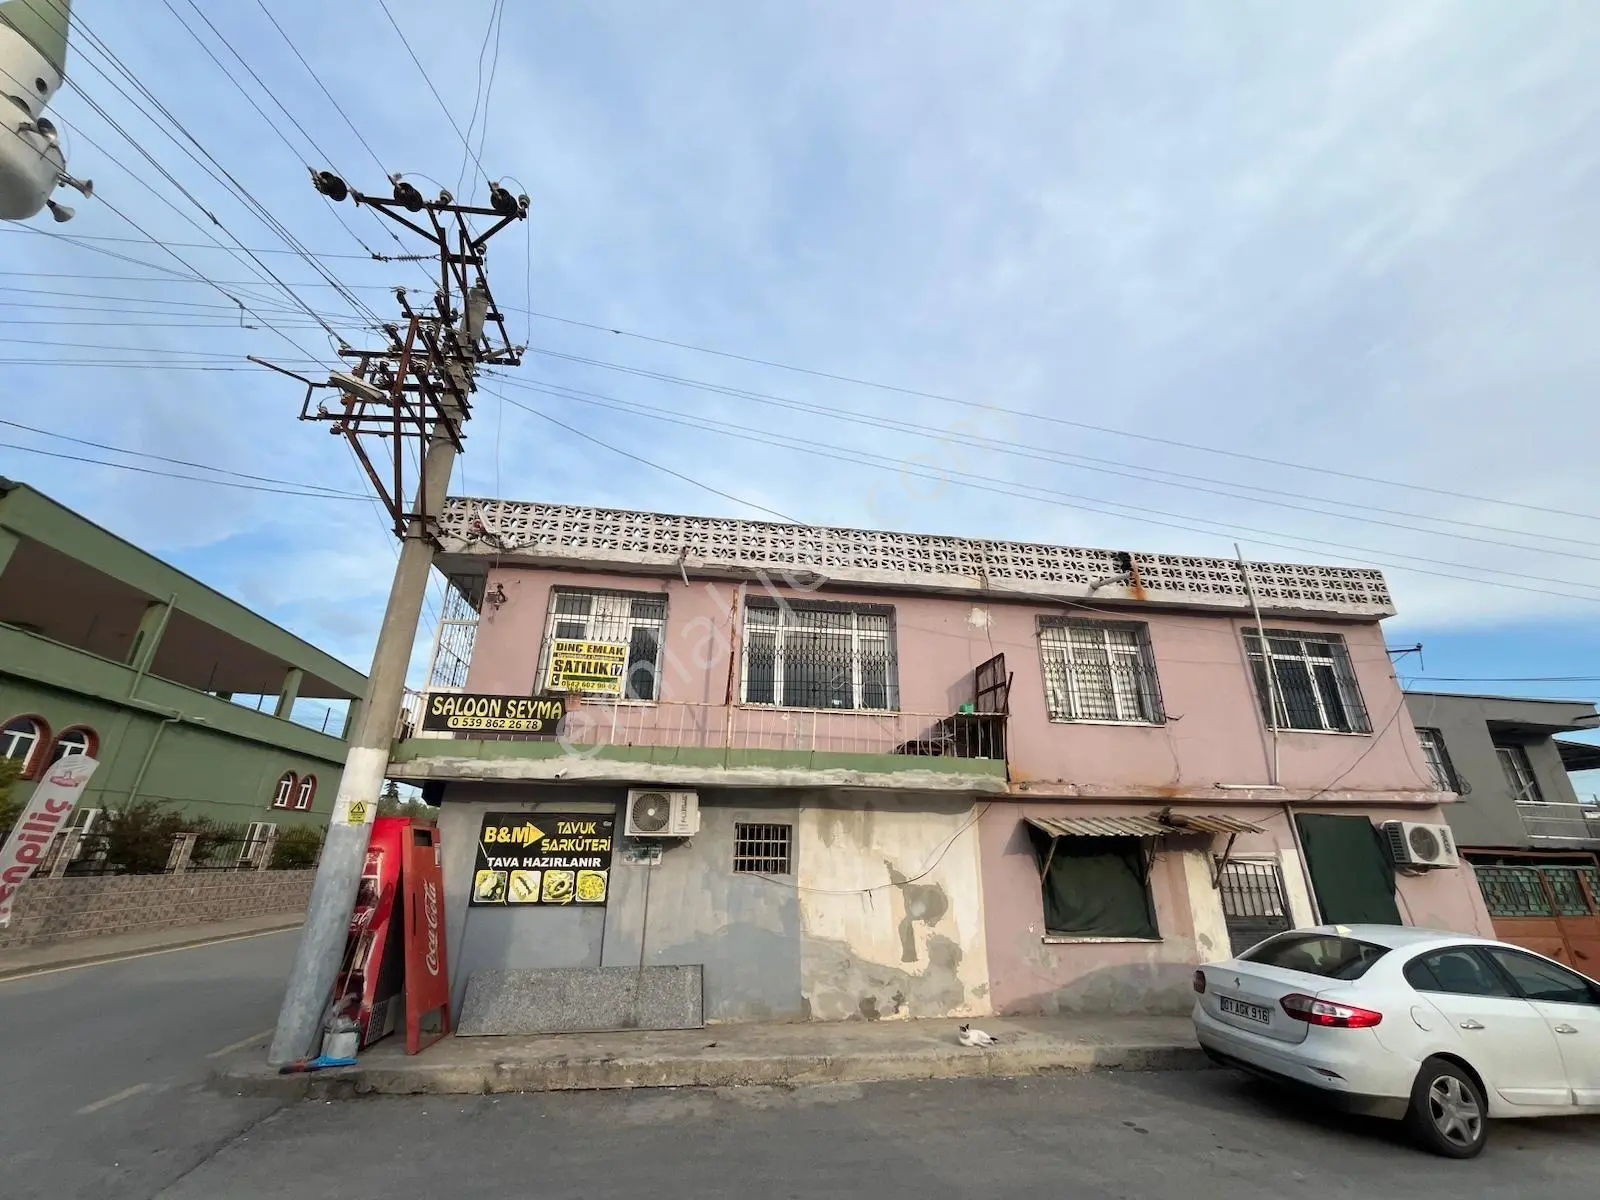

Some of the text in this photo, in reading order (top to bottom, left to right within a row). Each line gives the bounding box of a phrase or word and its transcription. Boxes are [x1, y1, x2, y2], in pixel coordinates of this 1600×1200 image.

[587, 644, 624, 655] EMLAK
[553, 659, 609, 676] SATILIK
[431, 696, 502, 717] SALOON
[452, 717, 539, 730] 0 539 862 26 78
[484, 826, 531, 843] B&M
[557, 822, 597, 834] TAVUK
[487, 857, 601, 868] TAVA HAZIRLANIR
[1224, 999, 1233, 1011] 01
[1251, 1007, 1268, 1022] 916
